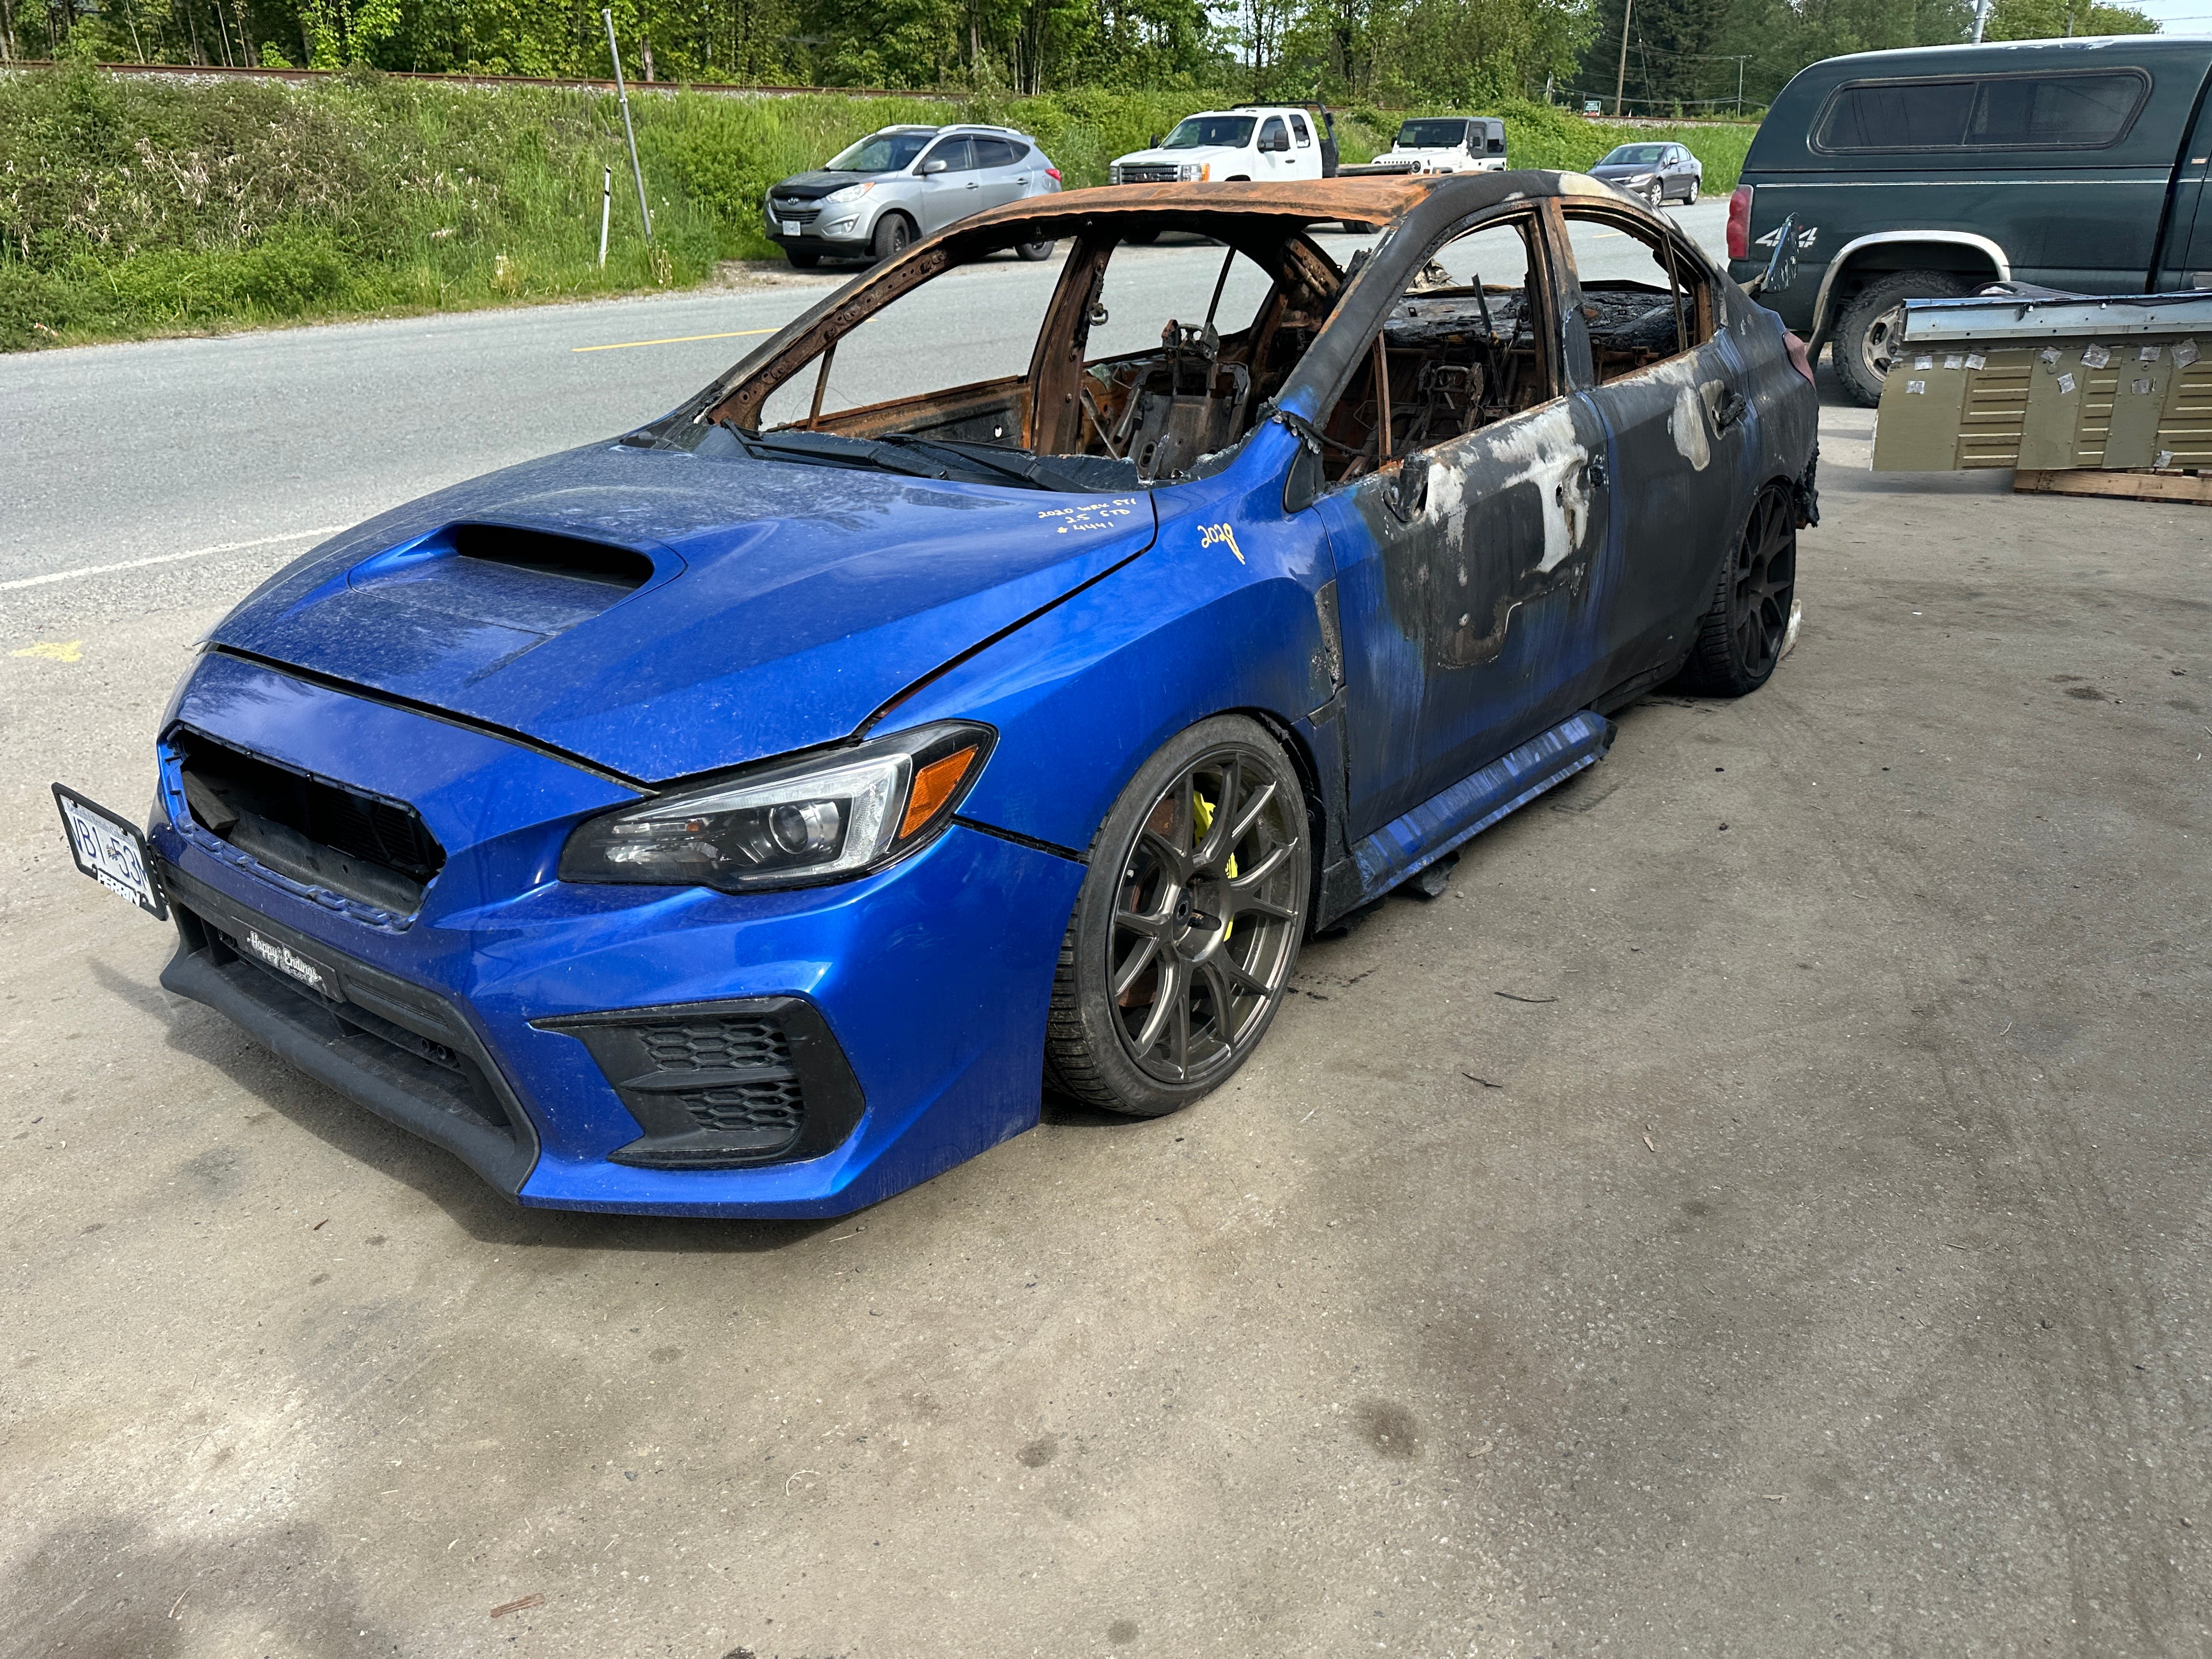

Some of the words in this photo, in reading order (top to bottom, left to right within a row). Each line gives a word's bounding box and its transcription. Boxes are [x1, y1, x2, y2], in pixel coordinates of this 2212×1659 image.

[1038, 508, 1074, 518] 2020
[1112, 498, 1137, 506] STI
[1065, 513, 1090, 523] 2.5
[97, 870, 141, 907] PERRIN
[250, 930, 281, 967] Happy
